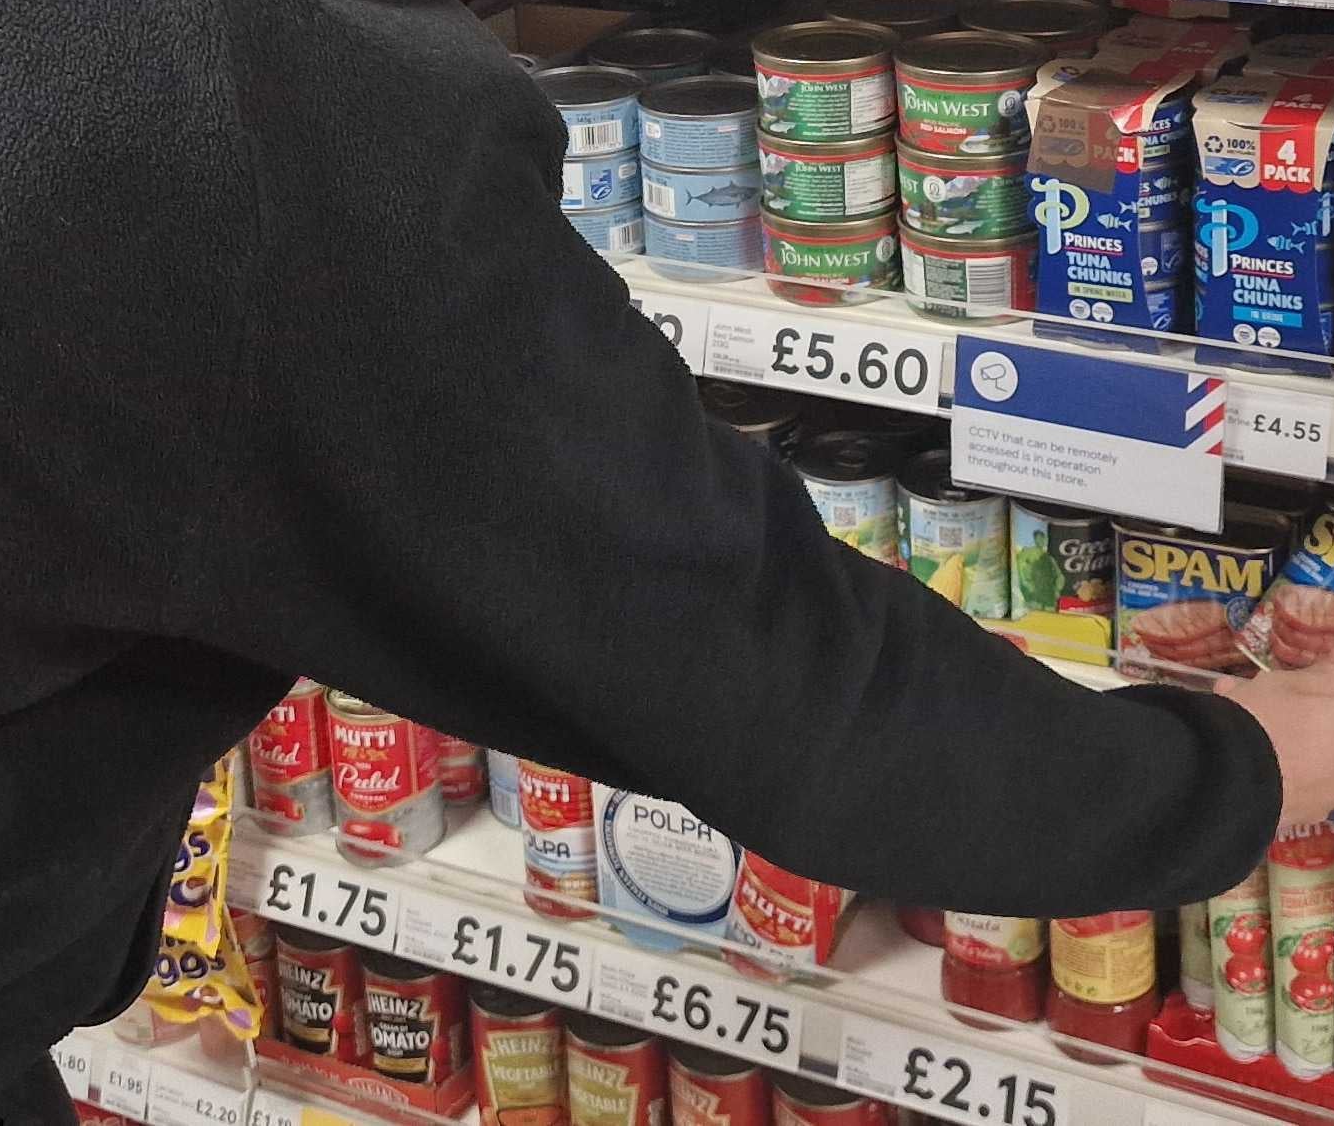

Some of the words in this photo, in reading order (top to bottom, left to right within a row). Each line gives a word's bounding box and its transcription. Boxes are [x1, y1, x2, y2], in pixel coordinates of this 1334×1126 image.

[1265, 164, 1311, 184] PACK
[1067, 253, 1111, 269] TUNA
[1067, 267, 1132, 285] CHUNKS
[772, 331, 929, 396] £5.60
[969, 426, 999, 439] CCTV
[1003, 434, 1023, 445] that
[1027, 440, 1046, 449] can
[1051, 441, 1064, 453] be
[1068, 446, 1117, 465] remotely
[1253, 414, 1321, 442] £4.55
[968, 456, 1028, 475] throughout
[1032, 467, 1051, 479] this
[1056, 473, 1087, 487] store.
[970, 442, 1018, 459] accessed
[1023, 452, 1030, 461] is
[1034, 455, 1043, 463] in
[1047, 457, 1100, 475] operation
[1121, 540, 1266, 597] SPAM
[335, 725, 395, 747] MUTTI
[267, 864, 388, 937] £1.75
[451, 916, 581, 992] £1.75
[651, 974, 791, 1055] £6.75
[903, 1046, 1058, 1123] £2.15
